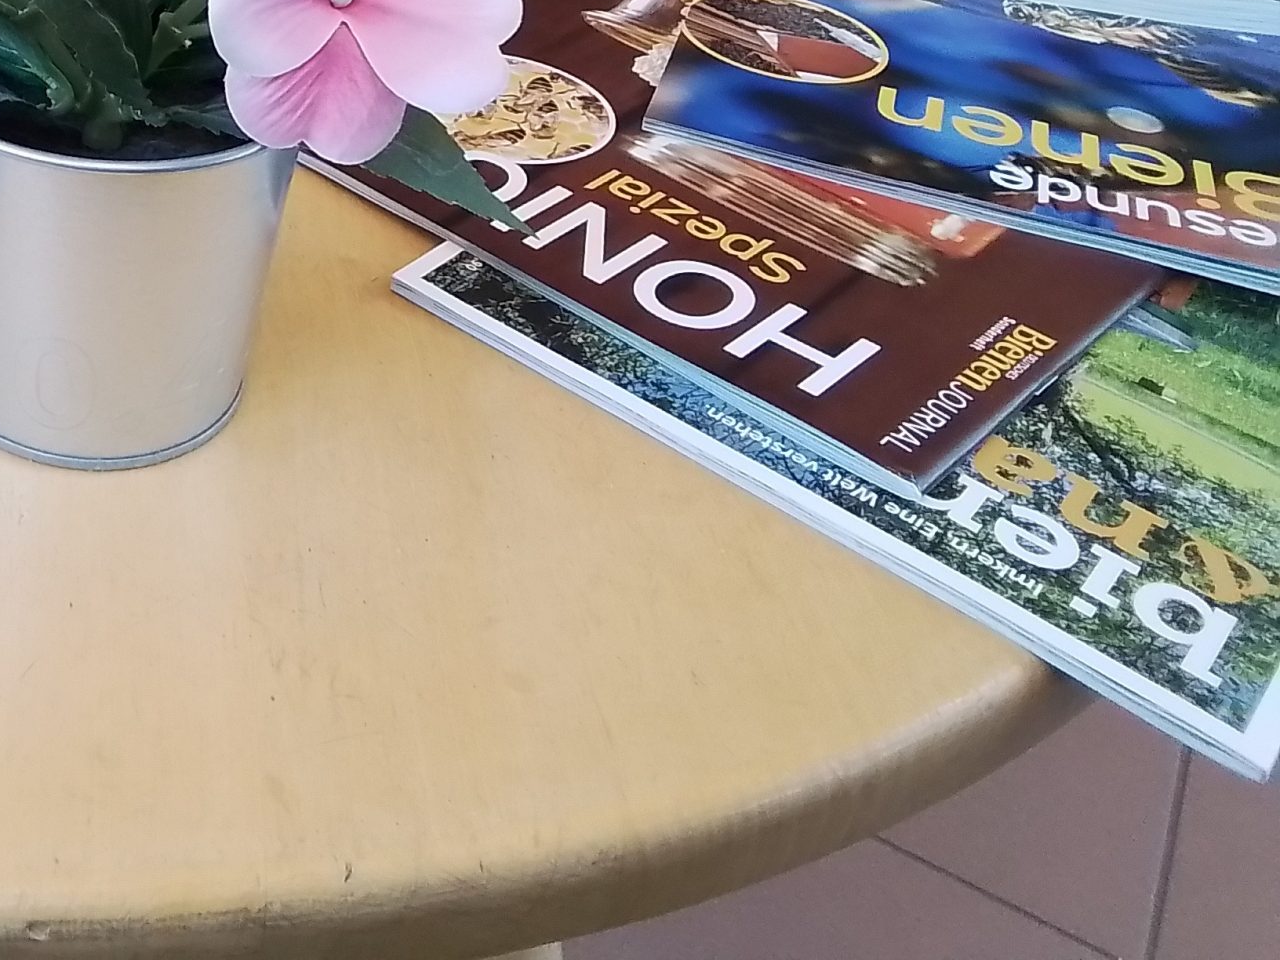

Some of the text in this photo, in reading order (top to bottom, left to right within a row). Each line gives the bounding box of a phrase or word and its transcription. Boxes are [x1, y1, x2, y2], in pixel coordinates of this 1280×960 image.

[583, 168, 807, 285] Spezial
[989, 161, 1278, 247] esunde
[968, 316, 1017, 351] Sonderheft
[879, 323, 1058, 453] Bienen JOURNAL
[1004, 353, 1039, 381] DEUTSCHES
[704, 403, 819, 473] verstehen.
[820, 469, 880, 511] Welt
[884, 501, 939, 540] Eine
